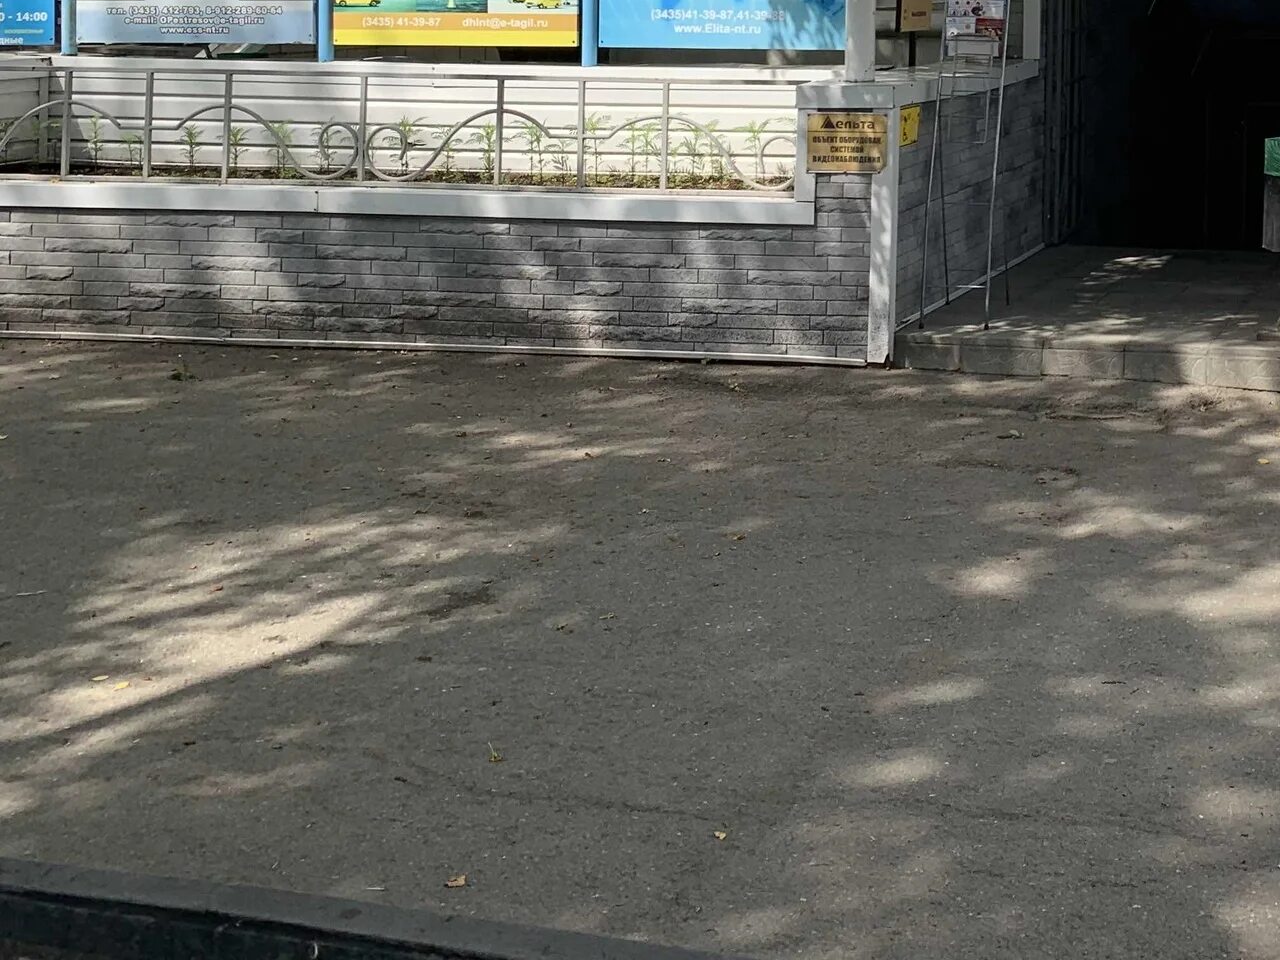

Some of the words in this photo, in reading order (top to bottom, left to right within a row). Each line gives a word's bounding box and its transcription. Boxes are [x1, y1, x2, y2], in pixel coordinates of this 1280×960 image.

[16, 12, 48, 21] 14:00
[362, 17, 394, 27] (3435)
[396, 17, 441, 26] 41-39-87
[674, 23, 761, 34] www.Elita-nt.ru
